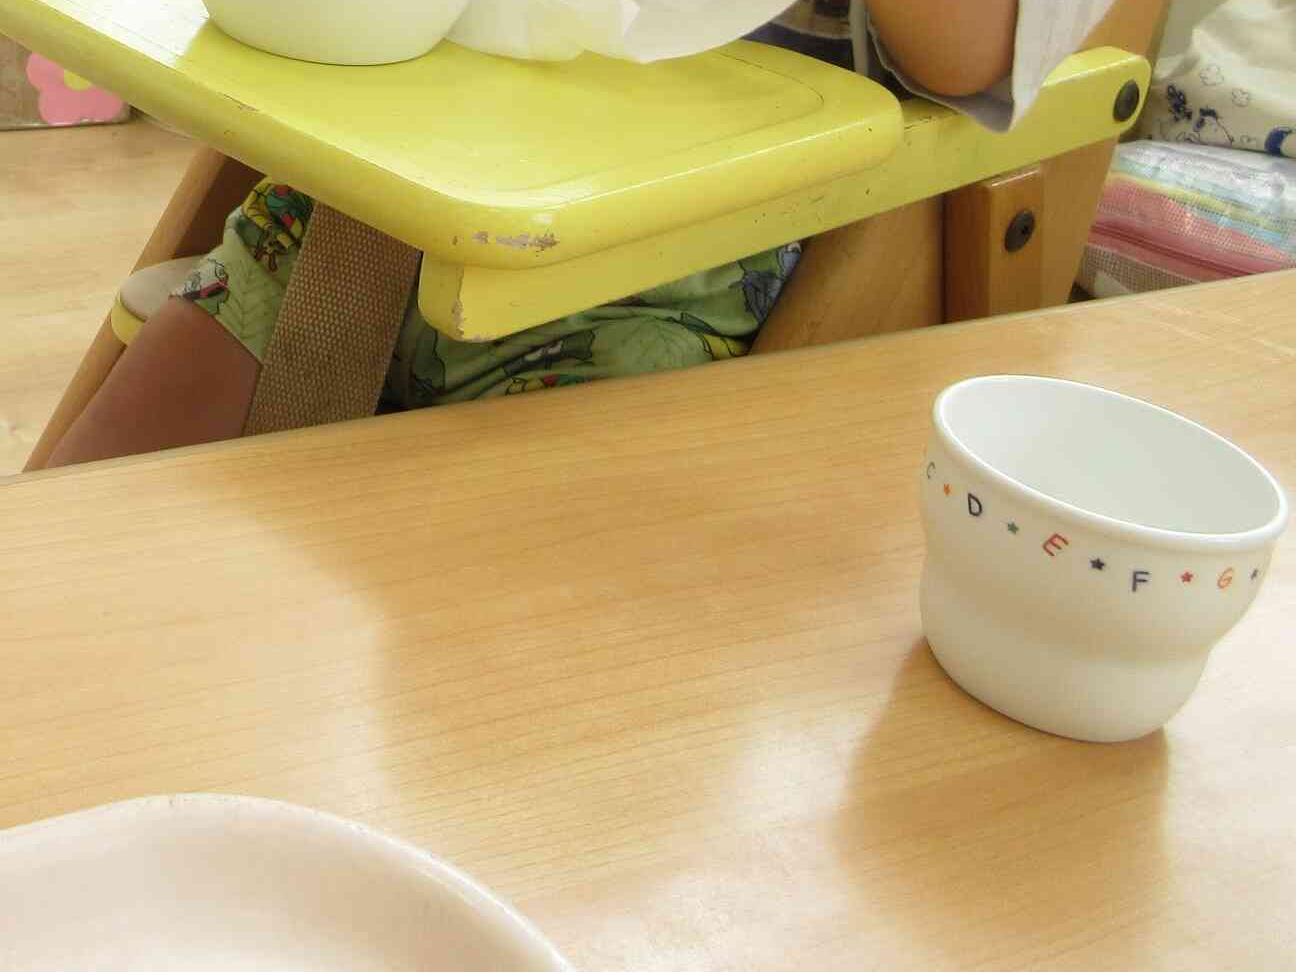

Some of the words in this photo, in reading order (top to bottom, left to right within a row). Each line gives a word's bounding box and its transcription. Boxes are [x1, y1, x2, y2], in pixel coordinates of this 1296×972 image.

[967, 492, 983, 517] D
[1041, 532, 1069, 557] E
[1131, 570, 1150, 593] F
[1216, 567, 1233, 590] G
